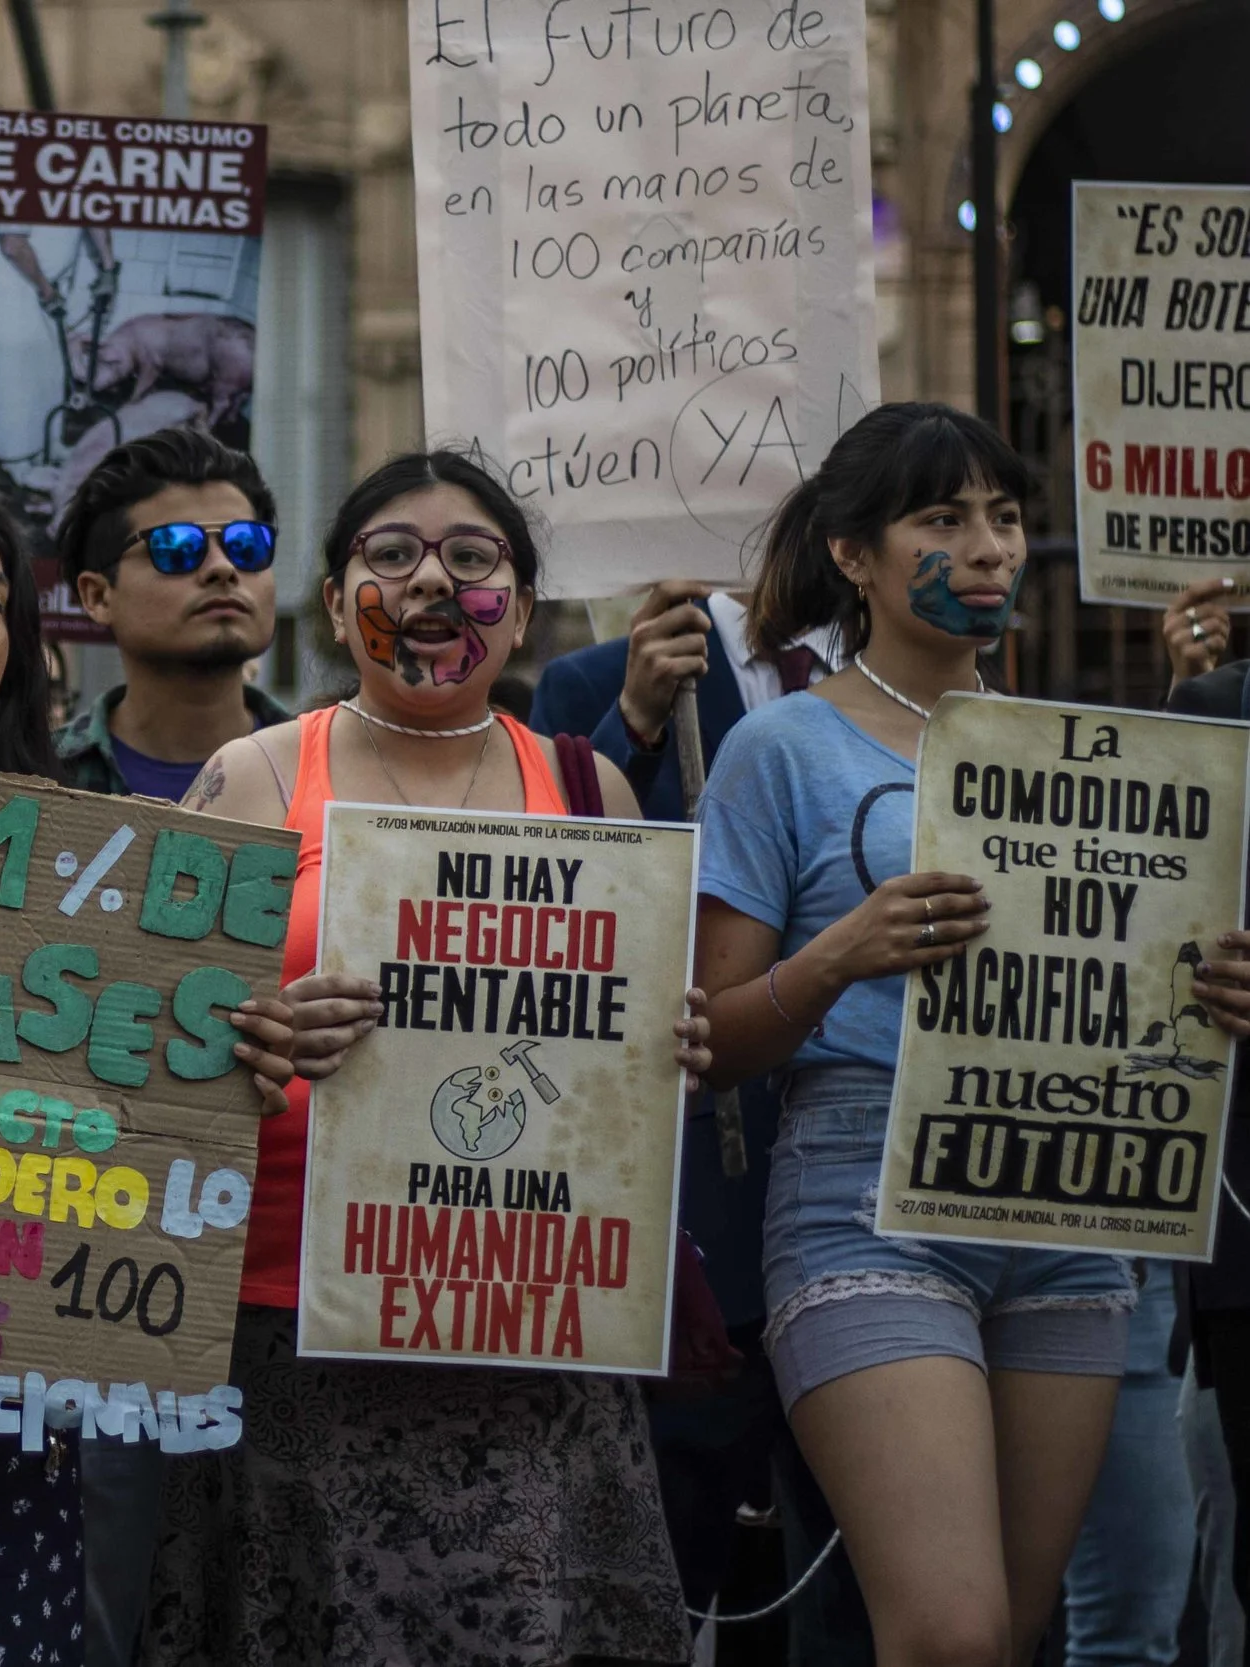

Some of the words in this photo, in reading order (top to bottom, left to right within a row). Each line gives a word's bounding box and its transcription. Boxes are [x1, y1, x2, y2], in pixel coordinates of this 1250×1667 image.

[426, 0, 493, 66] El
[534, 0, 737, 86] futuro
[767, 0, 831, 51] de
[56, 119, 107, 140] DEL
[115, 122, 255, 148] CONSUMO
[444, 97, 565, 153] todo
[596, 102, 643, 132] un
[669, 70, 854, 156] planeta,
[35, 143, 252, 196] CARNE,
[445, 185, 492, 216] en
[526, 165, 583, 213] las
[603, 163, 761, 203] manos
[789, 137, 843, 186] de
[38, 183, 250, 229] VÍCTIMAS
[513, 232, 600, 279] 100
[621, 218, 826, 283] compañías
[624, 286, 651, 328] y
[1077, 276, 1149, 329] UNA
[525, 350, 589, 412] 100
[610, 314, 798, 402] políticos
[1085, 440, 1113, 492] 6
[1106, 510, 1141, 551] DE
[1059, 714, 1122, 763] La
[376, 817, 408, 830] 27/09
[410, 819, 476, 834] MOVILIZACIÓN
[478, 824, 521, 837] MUNDIAL
[523, 826, 543, 838] POR
[545, 828, 558, 839] LA
[561, 828, 590, 842] CRISIS
[592, 828, 642, 844] CLIMÁTICA
[952, 761, 1211, 841] COMODIDAD
[139, 828, 297, 948] DE
[436, 851, 492, 899] NO
[503, 855, 583, 904] HAY
[982, 834, 1058, 874] que
[1073, 837, 1188, 881] tienes
[396, 899, 617, 973] NEGOCIO
[1043, 876, 1139, 942] HOY
[377, 961, 628, 1042] RENTABLE
[917, 944, 1129, 1050] SACRIFICA
[943, 1063, 1192, 1124] nuestro
[408, 1162, 493, 1208] PARA
[503, 1168, 572, 1212] UNA
[919, 1119, 1199, 1204] FUTURO
[160, 1158, 252, 1238] LO
[938, 1204, 1007, 1222] MOVILIZACIÓN
[1011, 1209, 1057, 1226] MUNDIAL
[1060, 1212, 1081, 1228] POR
[1083, 1214, 1097, 1229] LA
[1100, 1215, 1131, 1232] CRISIS
[343, 1201, 631, 1290] HUMANIDAD
[50, 1243, 186, 1336] 100
[379, 1276, 584, 1358] EXTINTA
